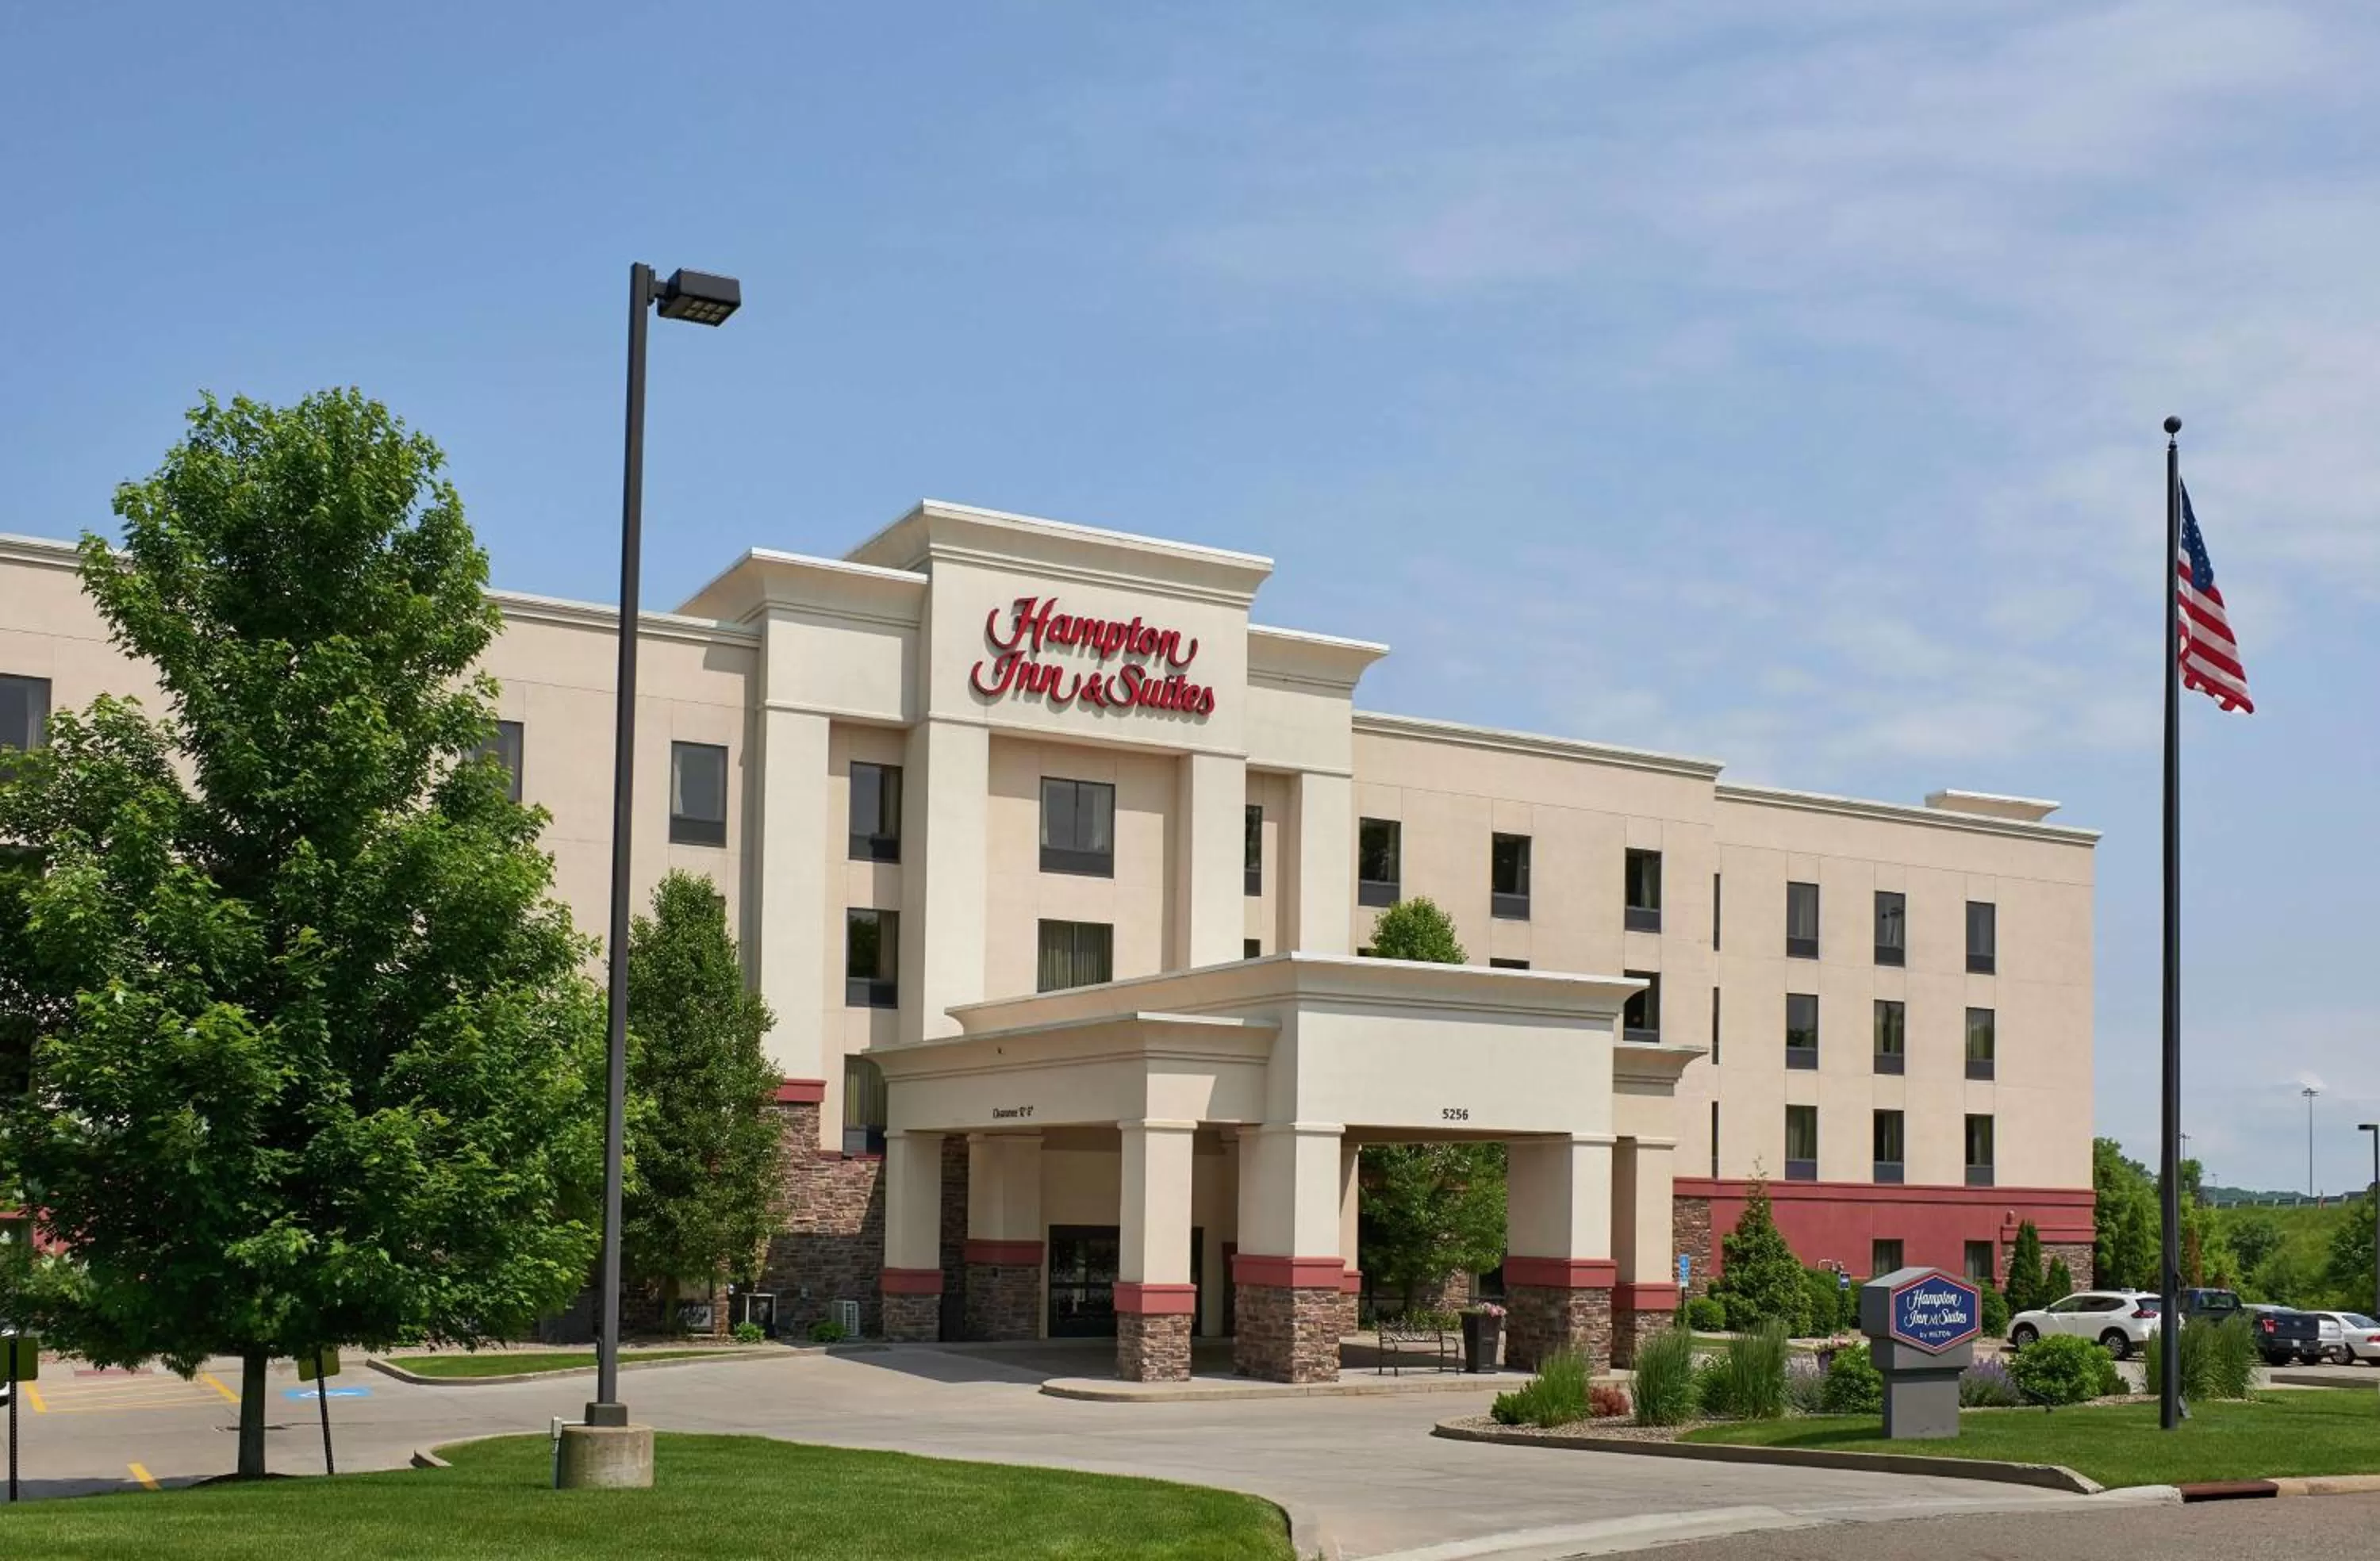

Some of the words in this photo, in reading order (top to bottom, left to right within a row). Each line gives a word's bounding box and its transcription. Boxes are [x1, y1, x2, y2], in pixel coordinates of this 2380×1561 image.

[986, 596, 1198, 667] Hampton
[970, 650, 1082, 703] Inn
[1081, 672, 1109, 708] &
[1104, 664, 1215, 715] Suites
[1441, 1108, 1468, 1120] 5256
[1906, 1288, 1962, 1310] Hampton
[1904, 1310, 1931, 1328] Inn
[1938, 1308, 1967, 1325] Suites
